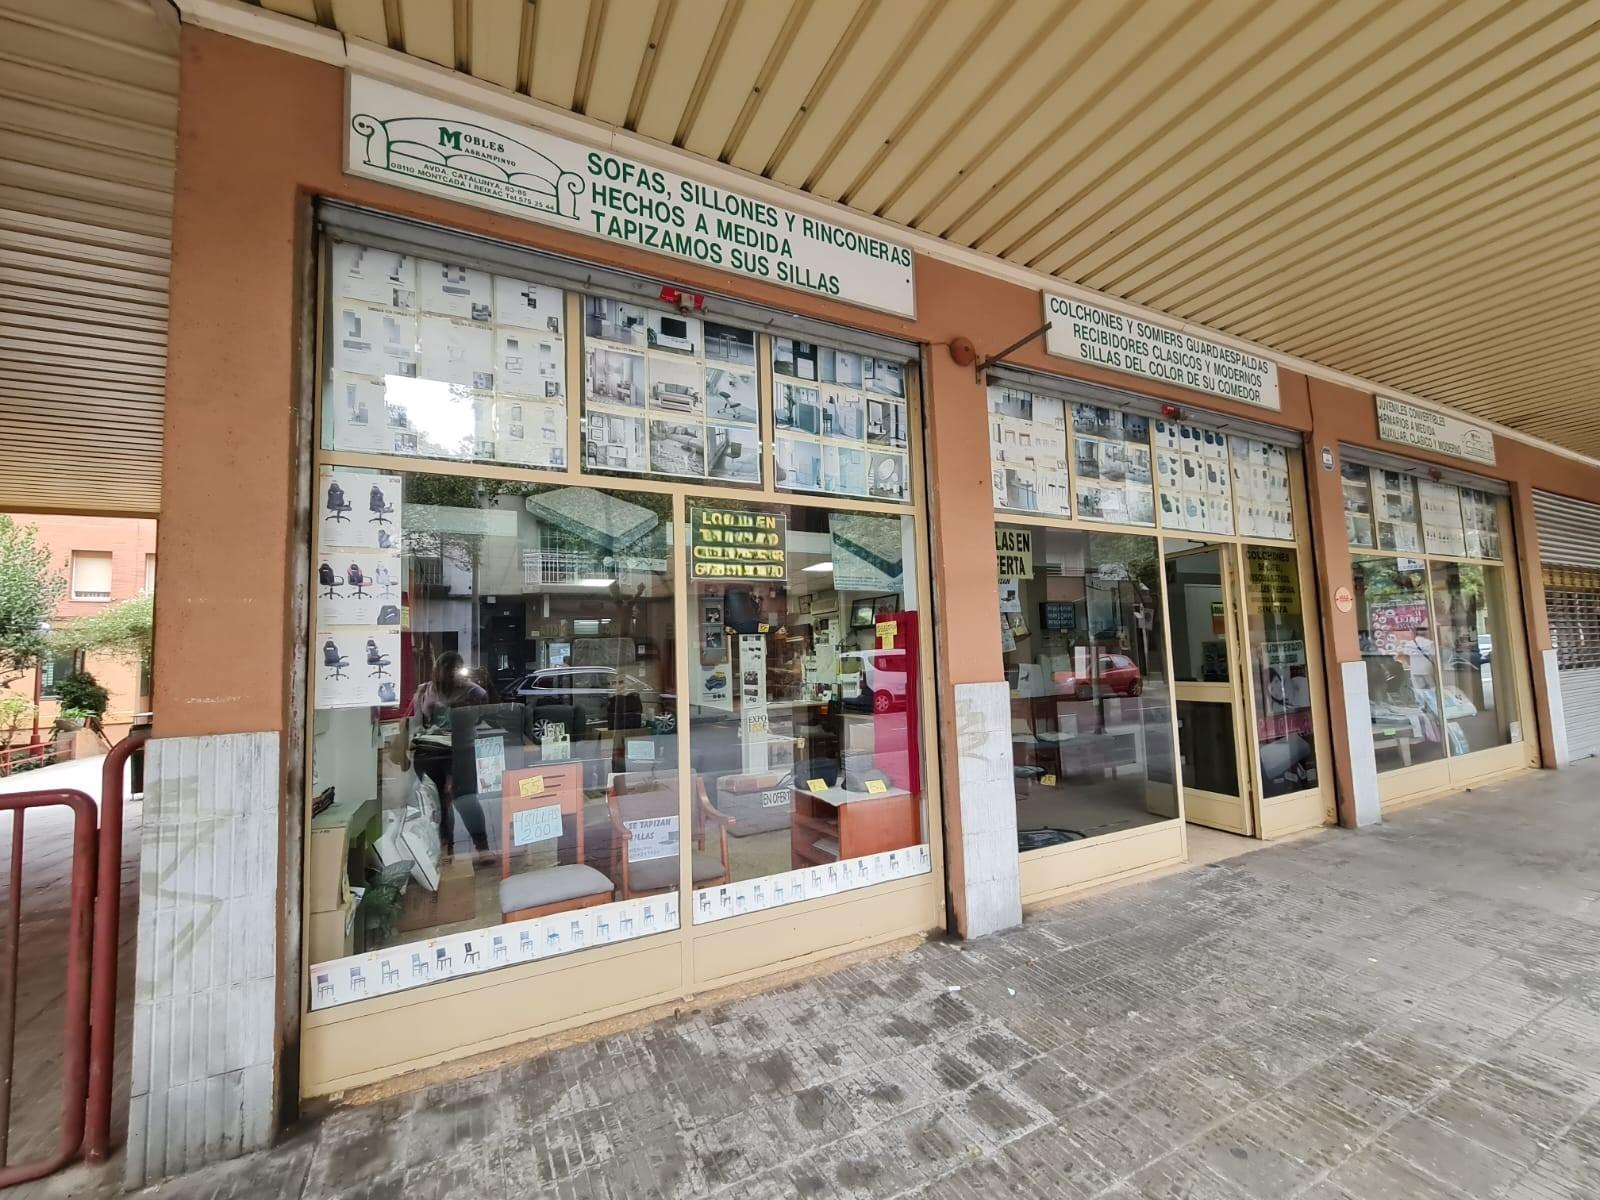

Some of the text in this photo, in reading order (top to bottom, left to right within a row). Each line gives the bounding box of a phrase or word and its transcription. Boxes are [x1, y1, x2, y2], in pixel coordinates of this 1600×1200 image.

[438, 127, 505, 153] MOBLES
[390, 162, 415, 173] 08110
[418, 169, 466, 188] MONTCADA
[474, 184, 503, 197] REIXAC
[587, 153, 911, 268] SOFAS, SILLONES Y RINCONERAS
[592, 183, 793, 258] HECHOS A MEDIDA
[591, 210, 840, 295] TAPIZAMOS SUS SILLAS
[1050, 297, 1269, 374] COLCHONES Y SOMIERS GUARDAESPALDAS
[1073, 323, 1262, 388] RECIBIDORES CLASICOS Y MODERNOS
[1080, 344, 1261, 403] SILLAS DEL COLOR DE SU COMEDOR
[997, 555, 1026, 576] ERTA
[1016, 532, 1030, 552] EN
[763, 793, 772, 806] EN
